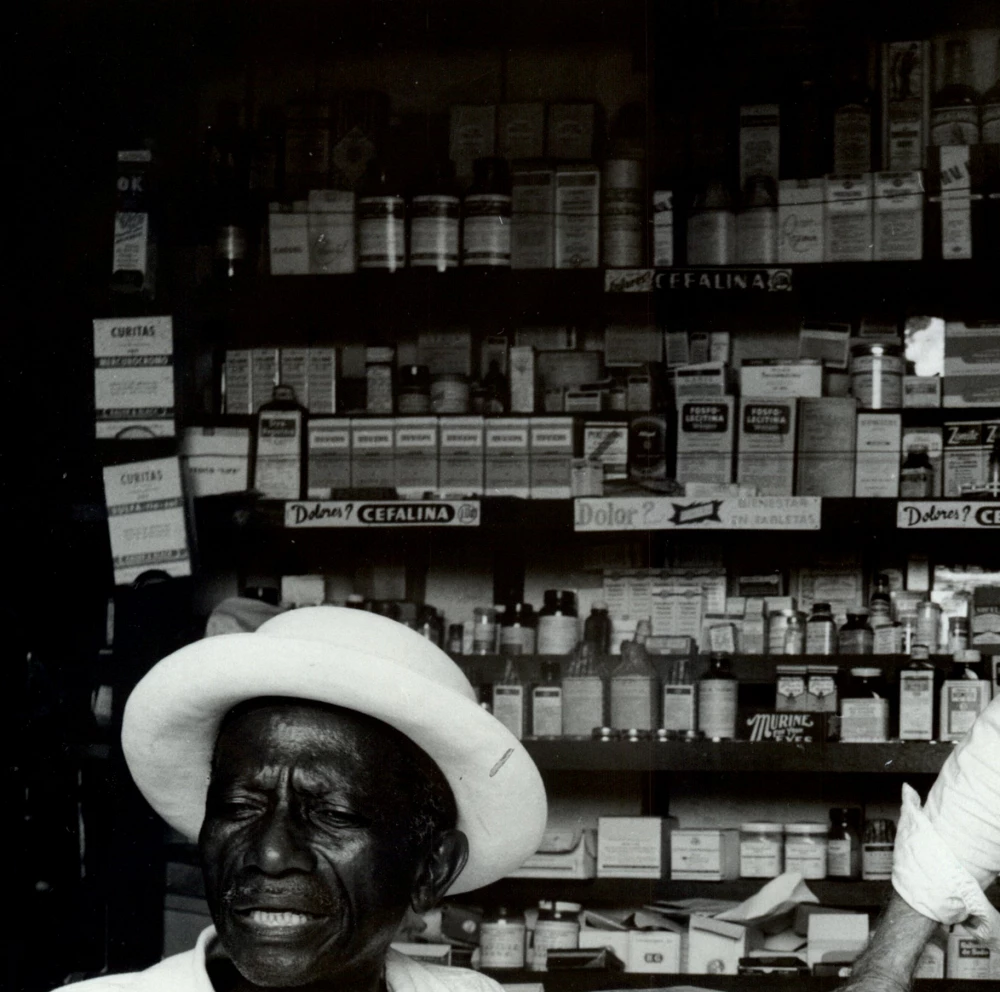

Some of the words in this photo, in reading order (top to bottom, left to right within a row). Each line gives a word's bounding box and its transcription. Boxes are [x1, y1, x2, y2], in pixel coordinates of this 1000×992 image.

[117, 176, 143, 191] OK
[654, 272, 764, 290] CEFALINA
[110, 325, 156, 338] CURITAS
[119, 470, 164, 486] CURITAS
[290, 503, 354, 525] Dolores?
[362, 506, 450, 522] CEFALINA
[577, 503, 638, 526] Dolor
[754, 514, 817, 526] TABLETAS
[903, 505, 971, 527] Dolores?
[747, 713, 815, 742] MURINE
